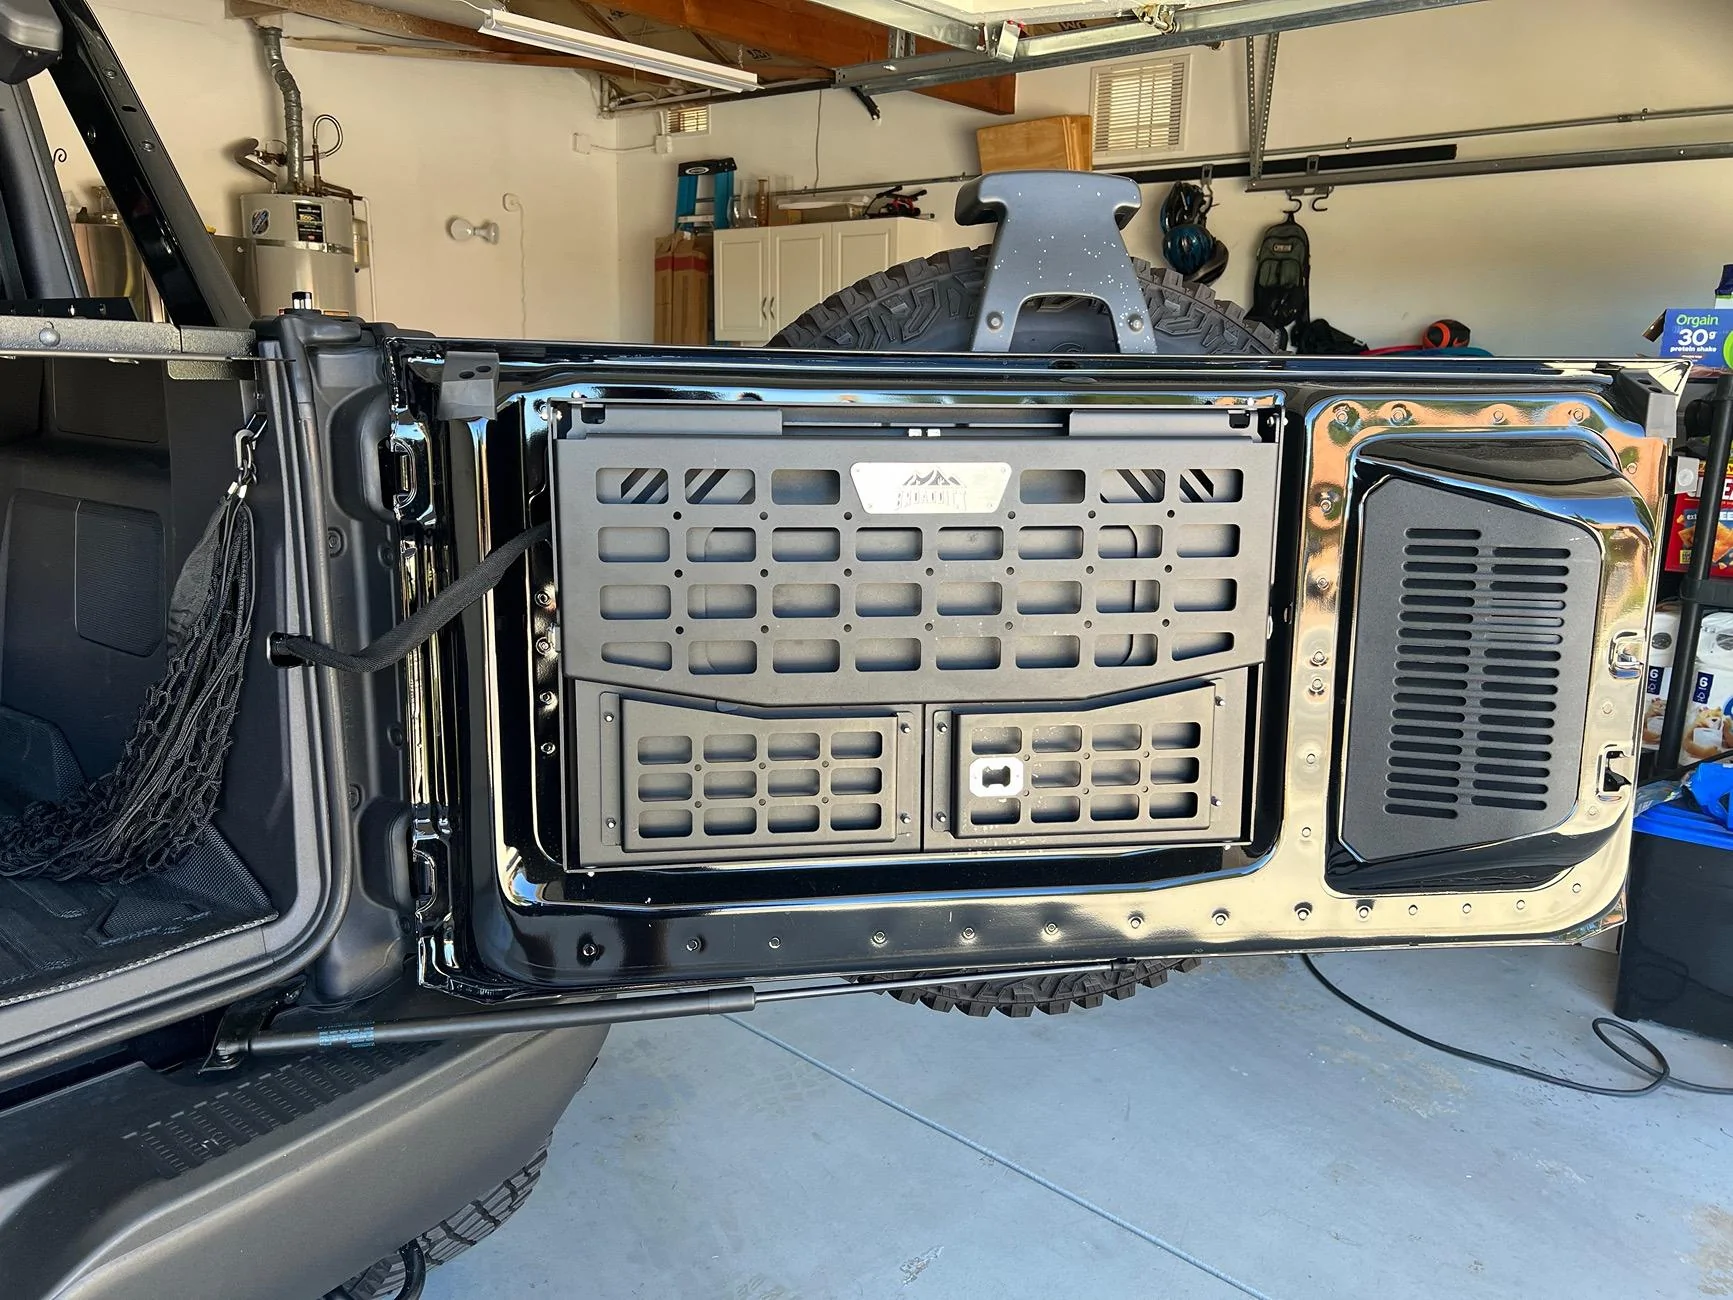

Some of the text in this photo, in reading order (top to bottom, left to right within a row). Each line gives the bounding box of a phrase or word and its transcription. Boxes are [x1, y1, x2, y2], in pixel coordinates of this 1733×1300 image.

[1676, 314, 1719, 328] Orgain
[1649, 668, 1659, 679] 6
[1699, 676, 1709, 688] 6
